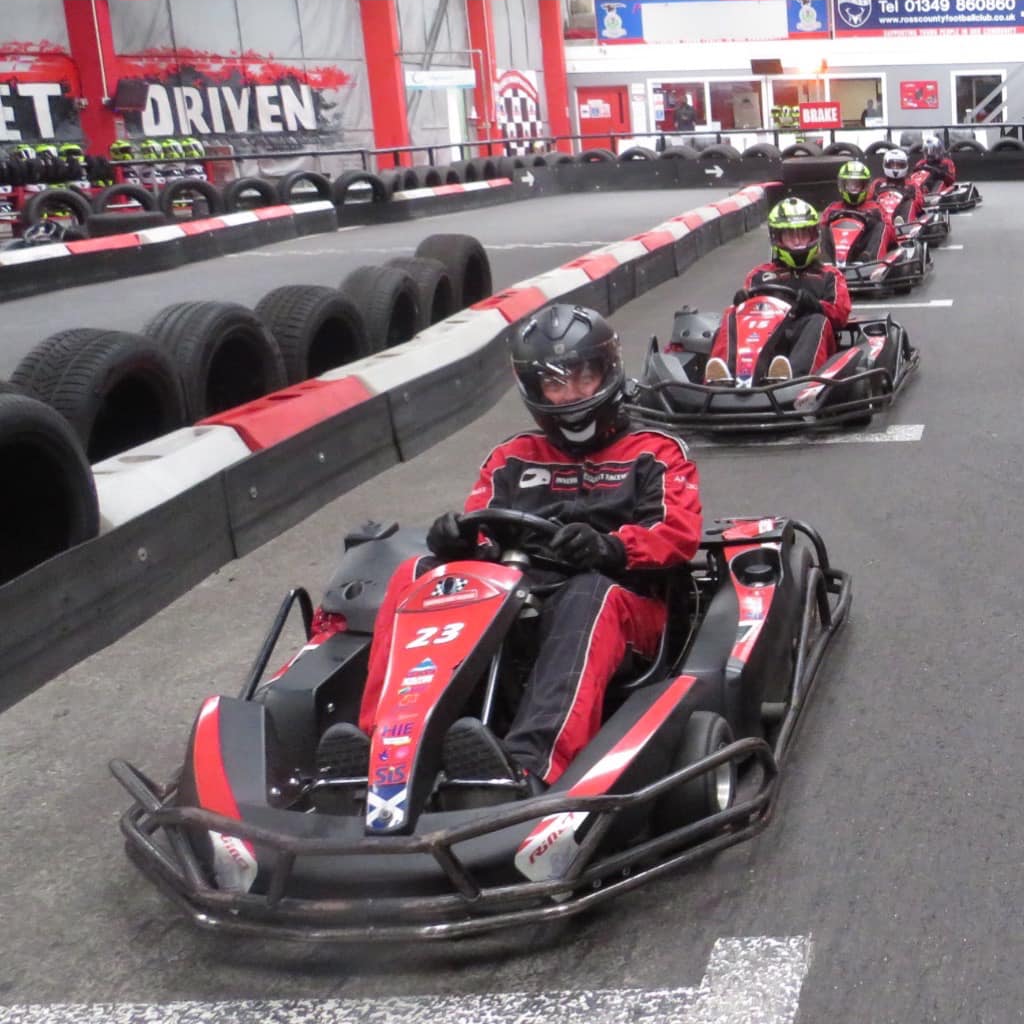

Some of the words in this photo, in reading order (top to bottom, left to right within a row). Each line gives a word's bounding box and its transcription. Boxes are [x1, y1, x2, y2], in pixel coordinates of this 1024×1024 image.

[878, 0, 899, 13] Tel
[904, 0, 950, 12] 01349
[142, 84, 318, 136] DRIVEN
[802, 107, 839, 124] BRAKE
[404, 622, 465, 649] 23
